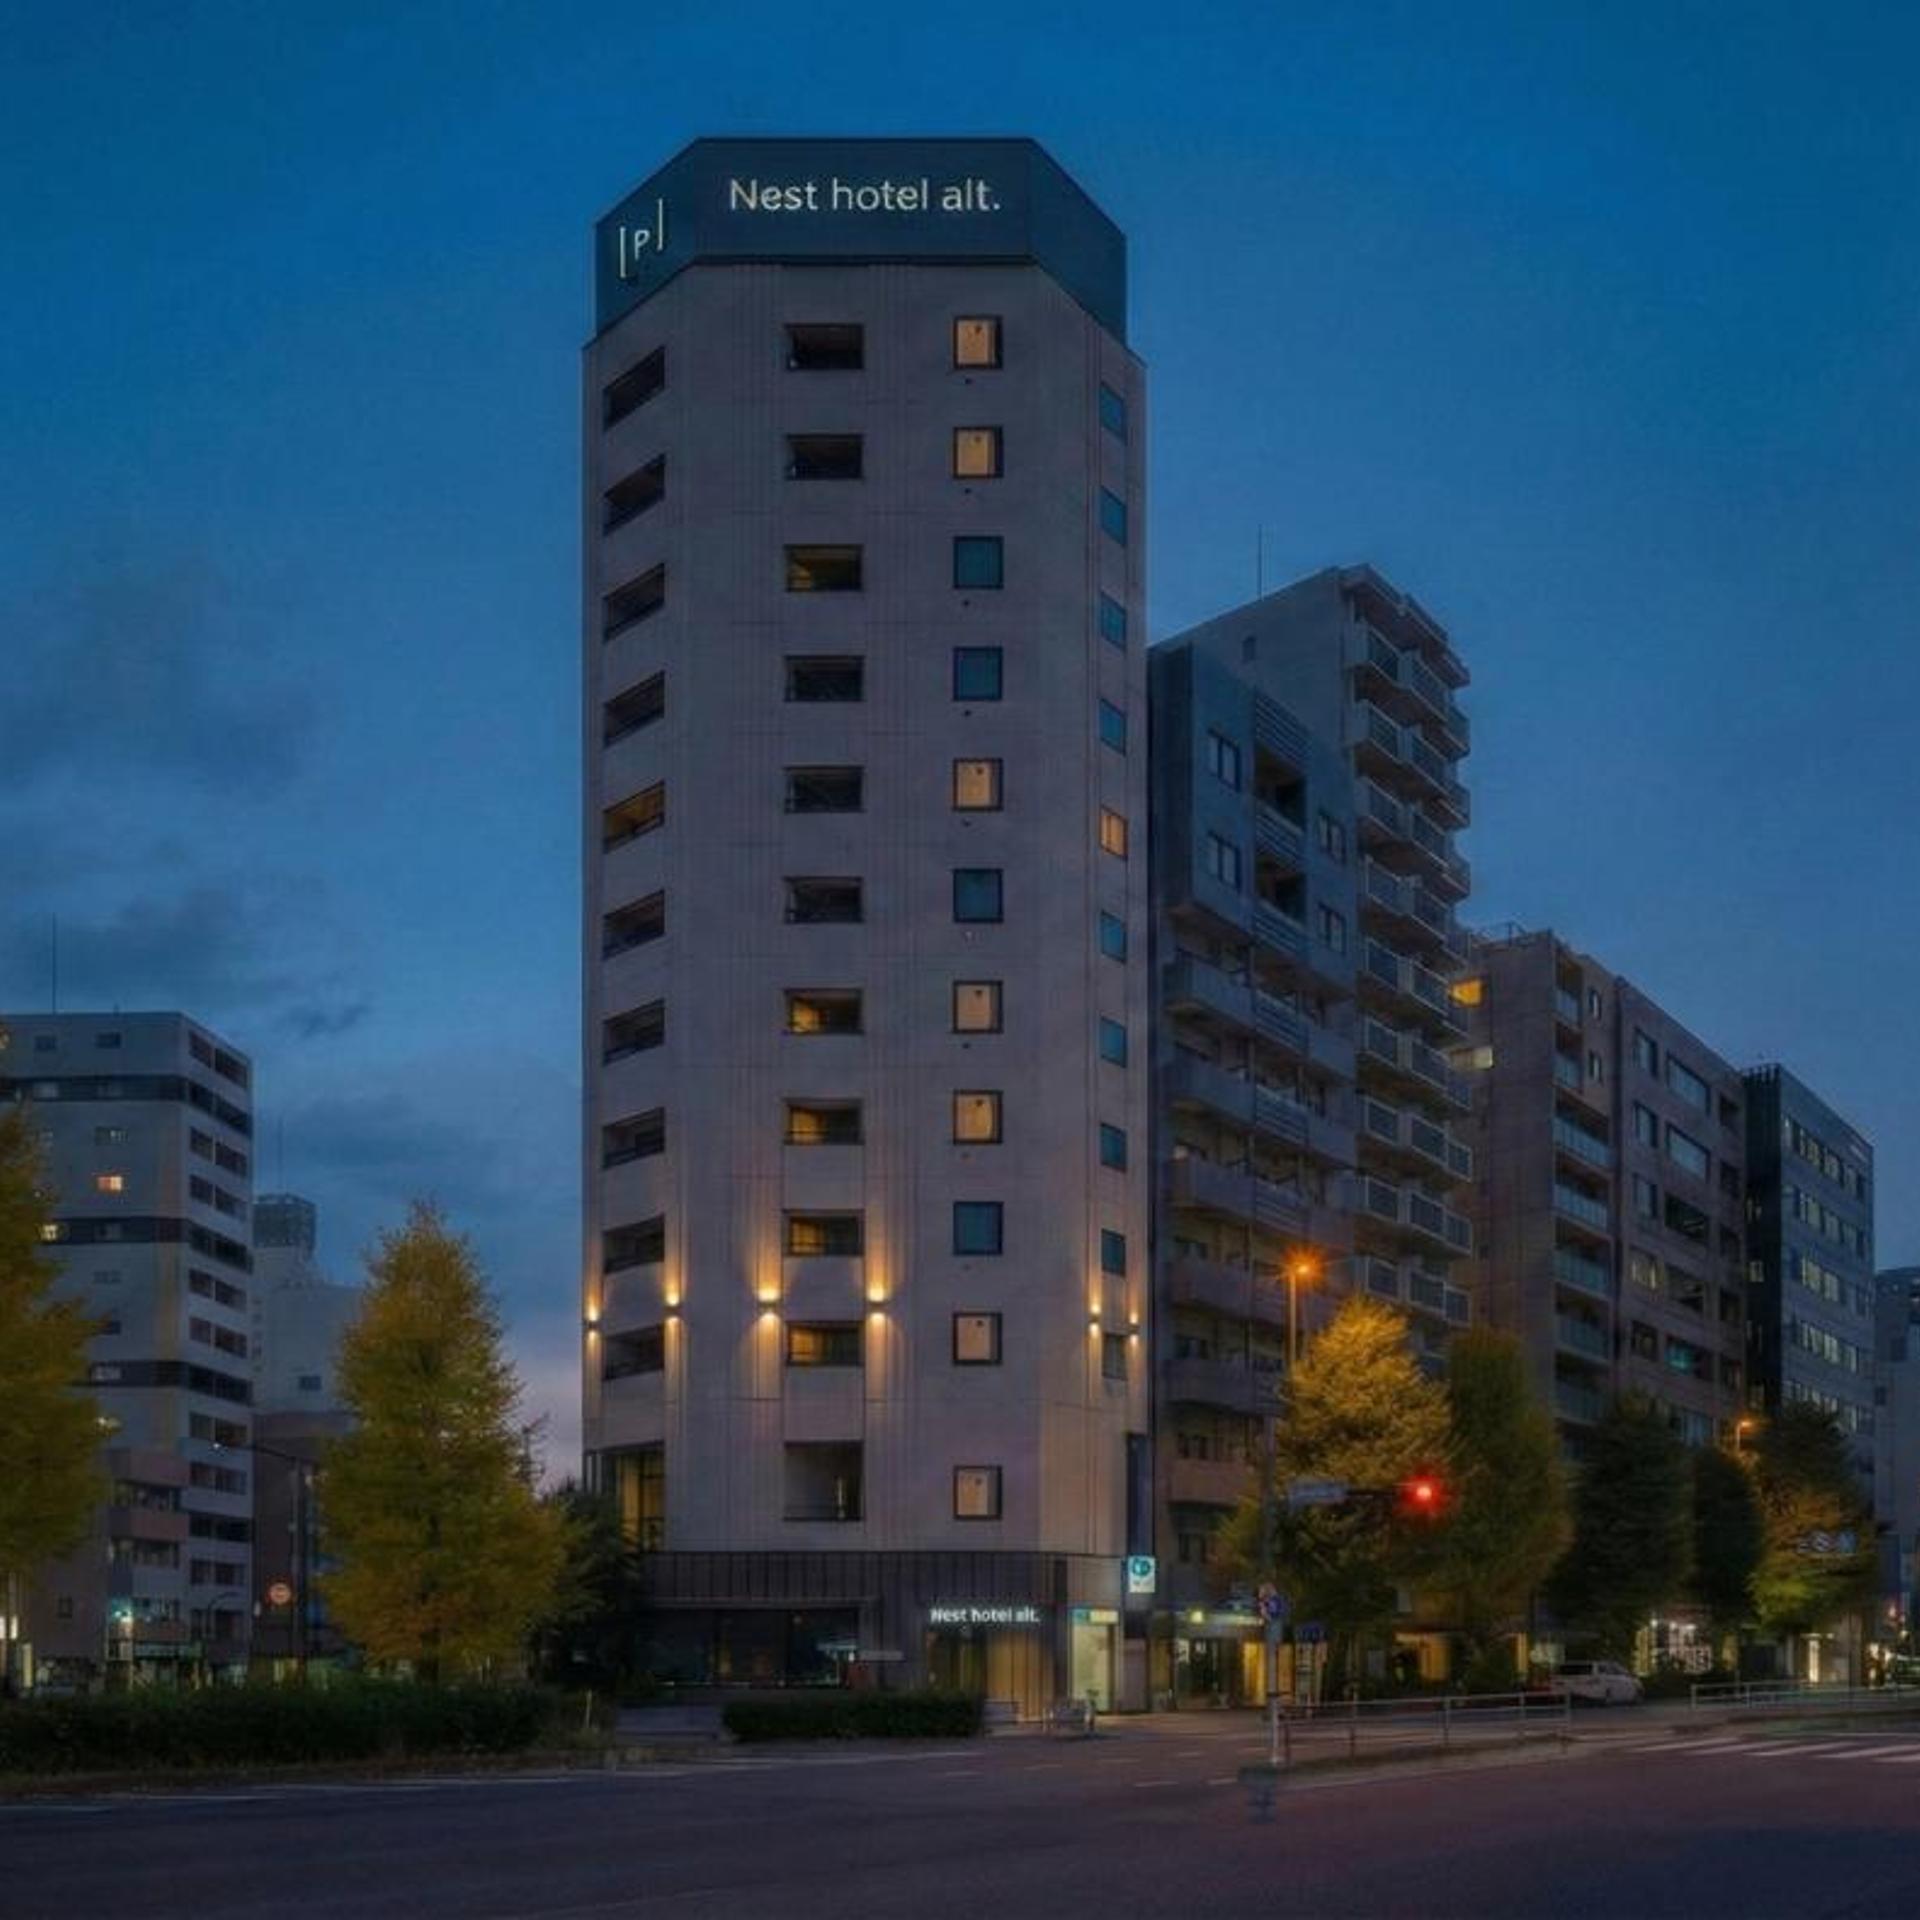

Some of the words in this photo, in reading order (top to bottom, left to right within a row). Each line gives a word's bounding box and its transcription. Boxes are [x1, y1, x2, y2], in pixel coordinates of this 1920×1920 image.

[730, 178, 818, 211] Nest
[833, 177, 928, 211] hotel
[942, 178, 1000, 211] alt.
[931, 1608, 966, 1623] Nest
[971, 1606, 1012, 1623] hotel
